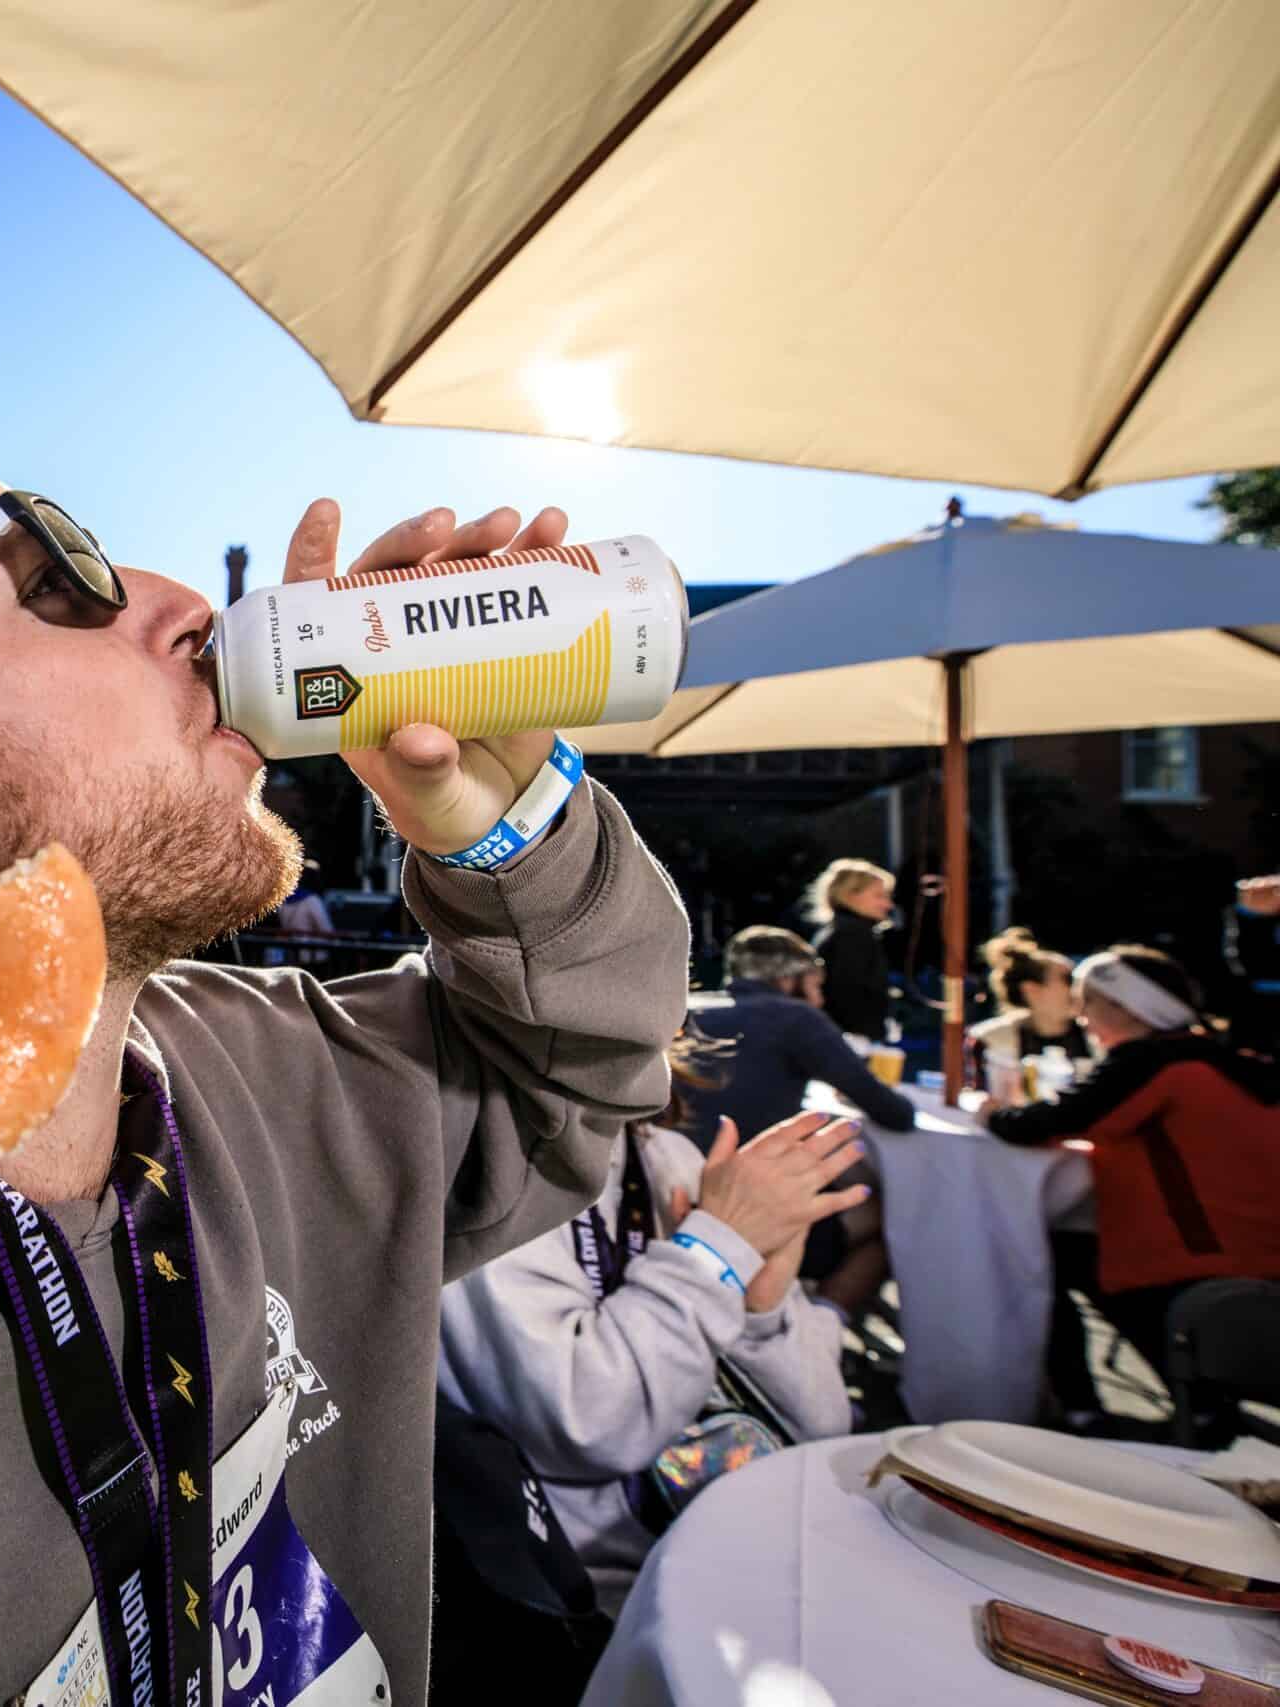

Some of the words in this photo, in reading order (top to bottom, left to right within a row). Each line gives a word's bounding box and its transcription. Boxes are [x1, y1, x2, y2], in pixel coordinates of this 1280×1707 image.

[270, 617, 281, 644] STYLE
[297, 623, 313, 642] 16
[363, 599, 391, 654] Amber
[403, 584, 551, 636] RIVIERA
[273, 647, 285, 695] MEXICAN
[635, 655, 646, 674] ABV
[306, 676, 338, 710] R&D
[267, 1301, 290, 1337] PTER
[299, 1400, 341, 1443] Pack
[212, 1472, 262, 1554] dward
[119, 1570, 153, 1707] RATHON
[212, 1563, 263, 1707] 3
